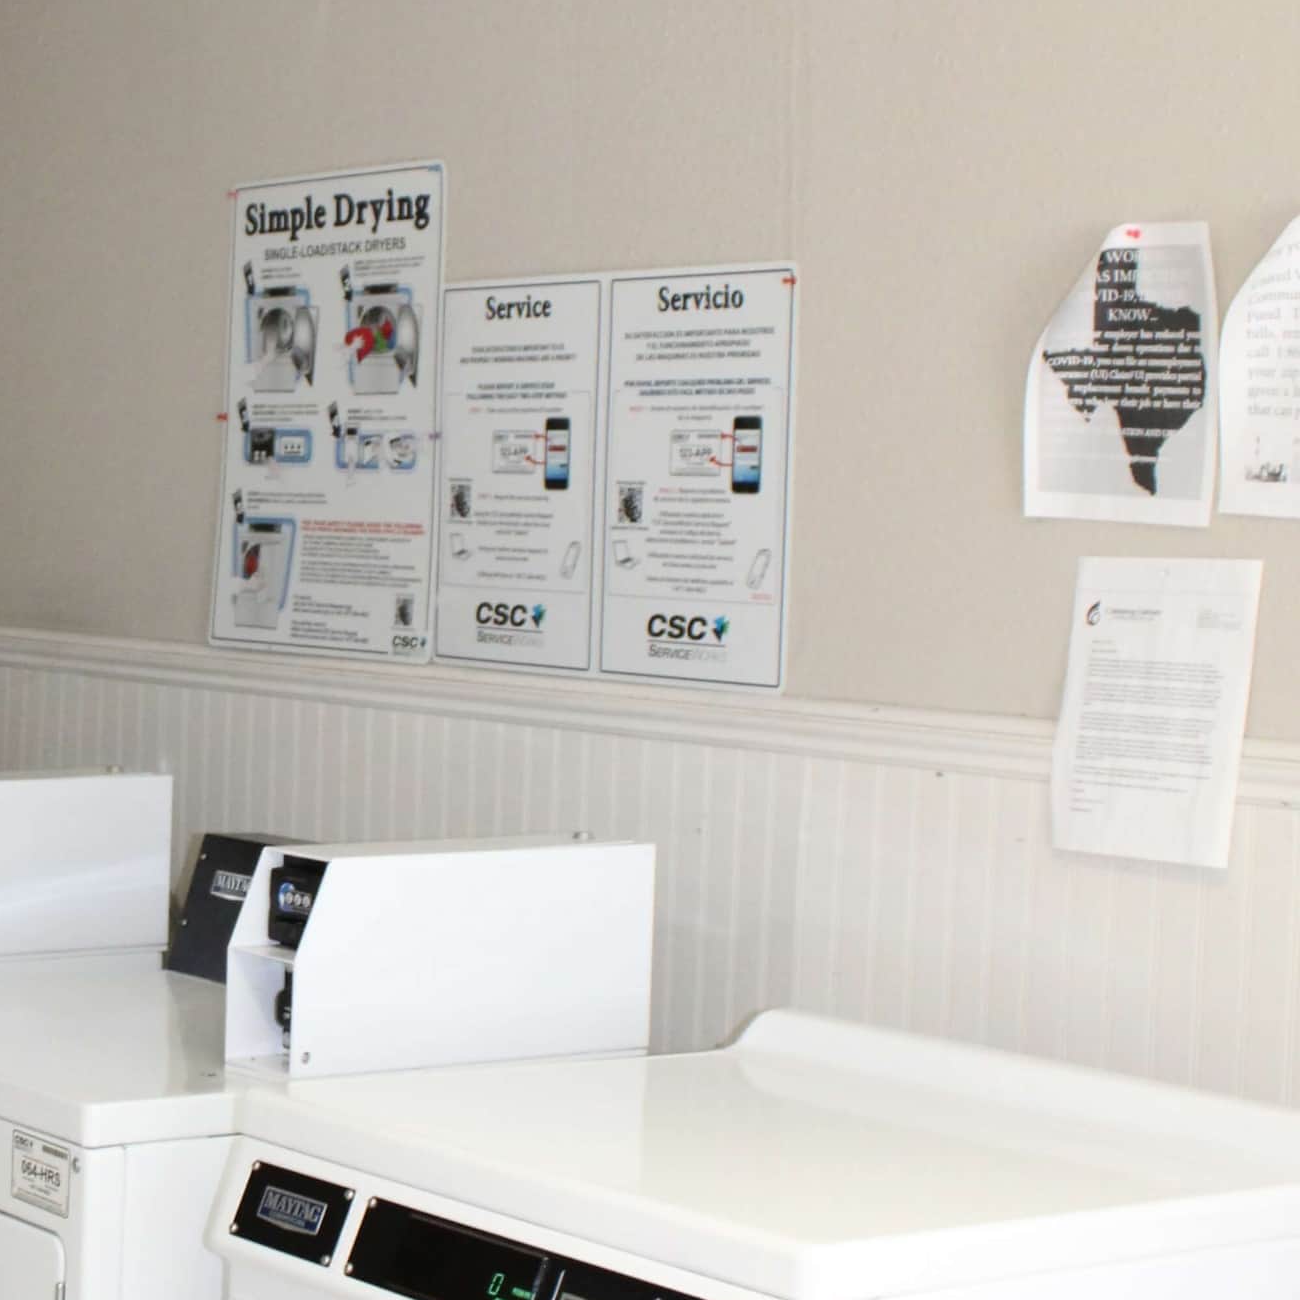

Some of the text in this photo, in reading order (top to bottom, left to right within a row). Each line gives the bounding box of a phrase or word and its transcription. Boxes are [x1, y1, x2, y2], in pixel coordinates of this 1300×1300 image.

[245, 188, 431, 241] Simple Drying
[364, 237, 406, 252] DRYERS
[486, 295, 552, 320] Service
[658, 284, 744, 311] Servicio
[475, 602, 528, 627] CSC
[647, 613, 707, 641] CSC
[392, 636, 417, 649] CSC
[263, 1189, 321, 1222] MAYTAG
